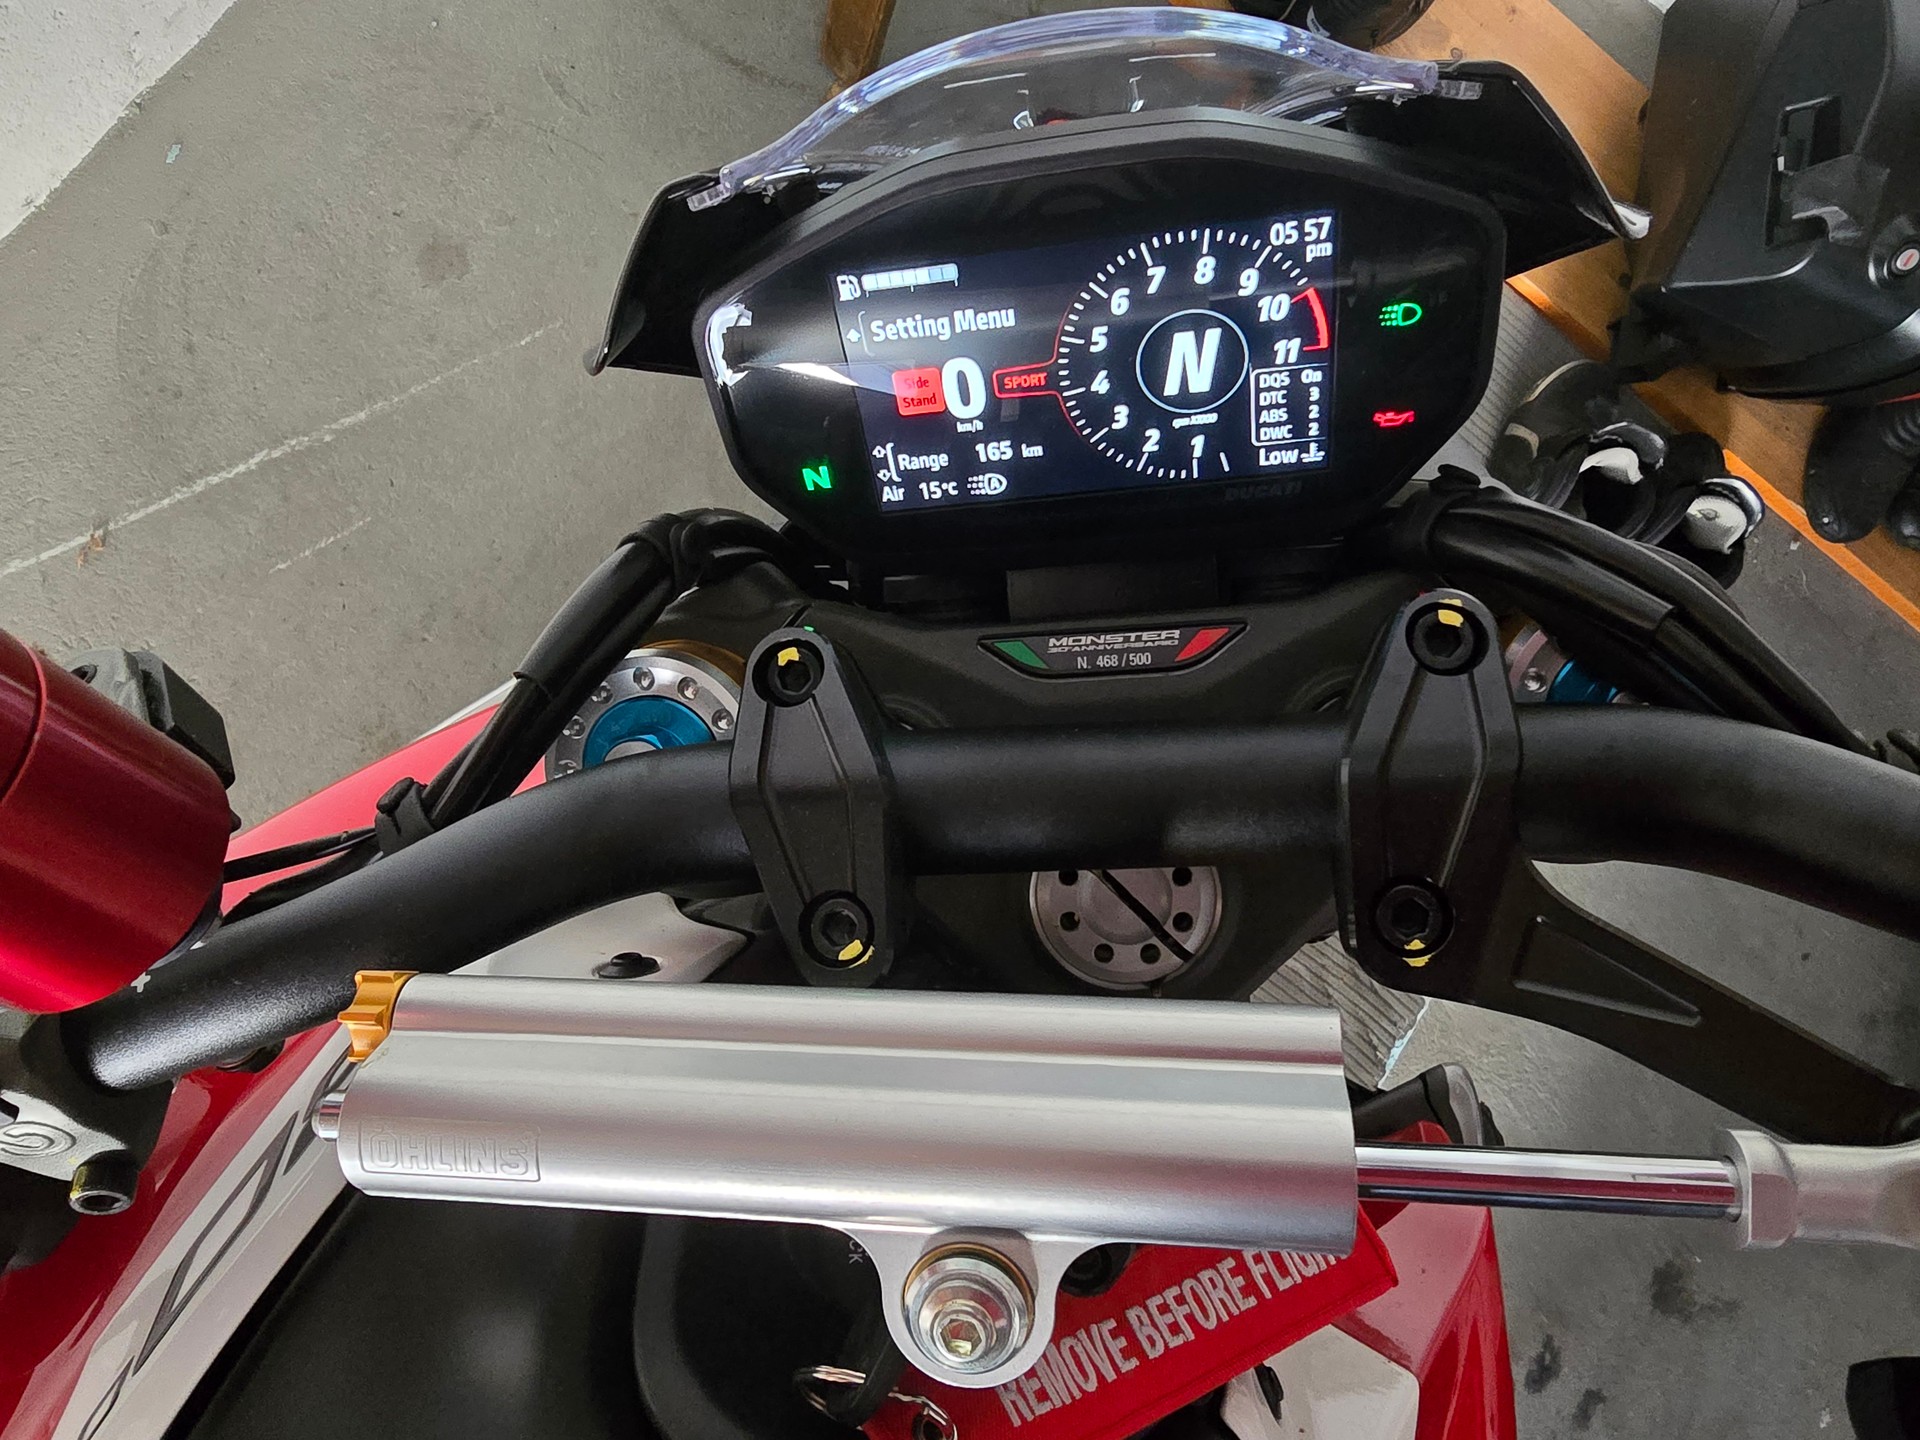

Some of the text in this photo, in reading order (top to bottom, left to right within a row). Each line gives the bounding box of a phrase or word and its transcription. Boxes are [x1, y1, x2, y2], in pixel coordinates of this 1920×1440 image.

[1269, 216, 1333, 246] 05 57
[1305, 242, 1333, 262] pm
[1147, 266, 1166, 294] 7
[1194, 256, 1216, 284] 8
[1238, 268, 1260, 296] 9
[1110, 288, 1130, 315] 6
[1257, 293, 1290, 322] 10
[870, 308, 1016, 342] Setting Menu
[1090, 326, 1108, 352] 5
[1274, 338, 1301, 364] 11
[1163, 327, 1222, 397] N
[904, 376, 929, 389] Side
[942, 357, 987, 419] 0
[1003, 372, 1048, 390] SPORT
[1090, 370, 1110, 395] 4
[1259, 369, 1323, 388] DQS On
[903, 392, 937, 409] Stand
[1259, 386, 1320, 406] DTC 3
[957, 420, 984, 433] km/h
[1111, 404, 1130, 430] 3
[1259, 404, 1320, 424] ABS 2
[1143, 428, 1161, 452] 2
[1260, 422, 1320, 440] DWC 2
[898, 440, 1044, 472] Range 165 km
[1190, 435, 1205, 457] 1
[1259, 448, 1300, 466] Low
[802, 465, 832, 491] N
[882, 484, 906, 502] Air
[1048, 630, 1181, 647] MONSTER
[1096, 654, 1119, 668] 468
[1128, 652, 1152, 666] 500
[995, 1319, 1139, 1427] REMOVE
[1126, 1256, 1258, 1359] BEFORE
